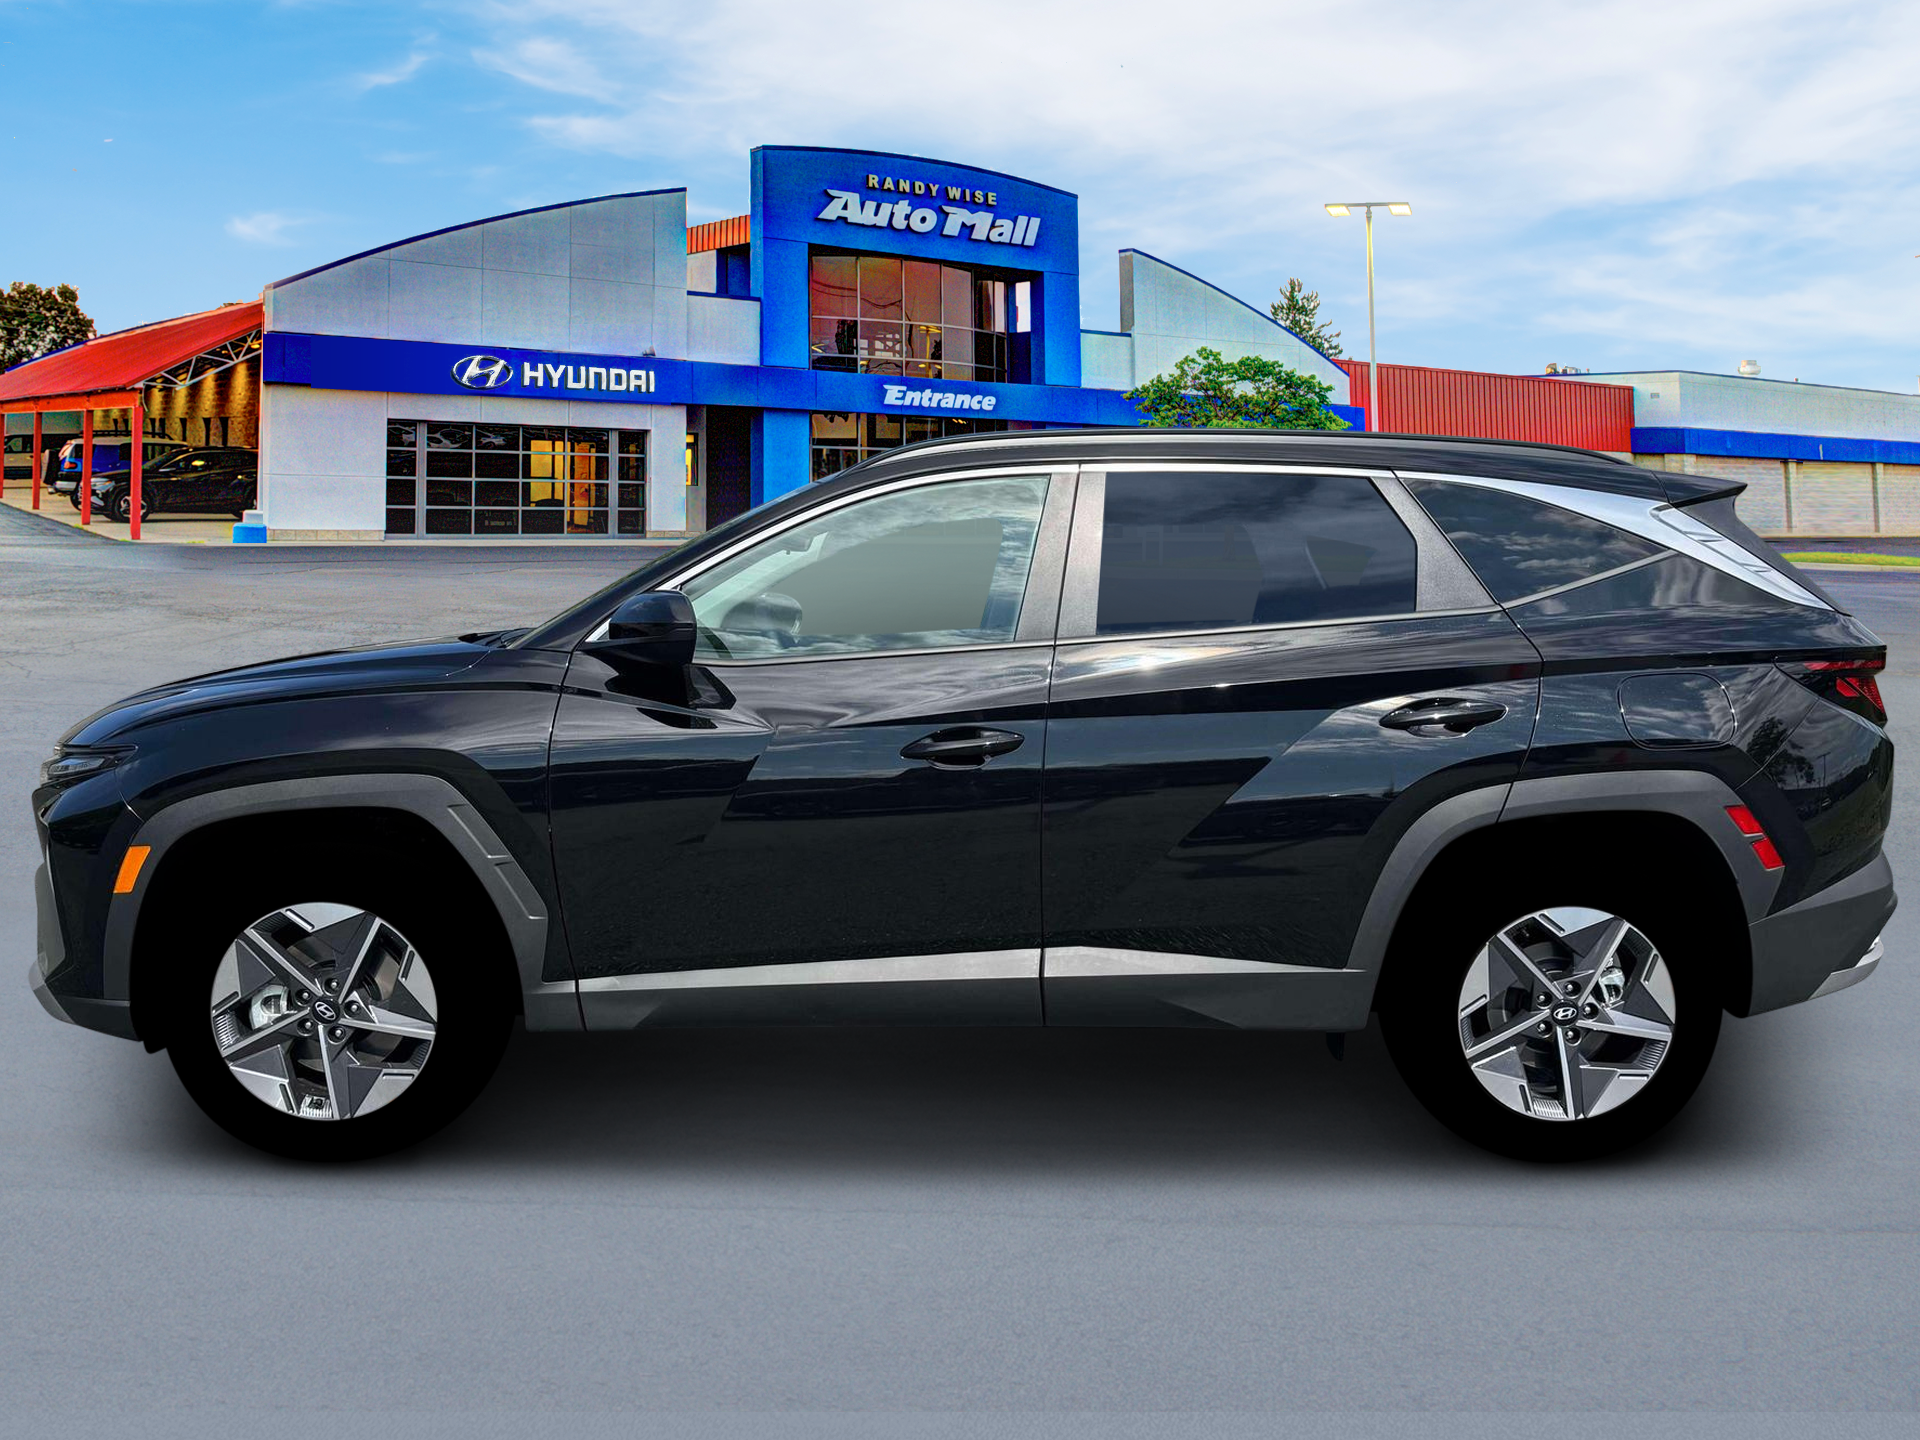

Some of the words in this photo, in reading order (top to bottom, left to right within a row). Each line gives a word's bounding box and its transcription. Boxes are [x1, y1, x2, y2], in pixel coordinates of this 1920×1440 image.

[867, 174, 939, 197] RANDY
[947, 186, 998, 206] WISE
[817, 188, 938, 233] Auto
[941, 205, 1041, 246] Mall
[523, 362, 656, 392] HYUNDAI
[883, 384, 997, 411] Entrance
